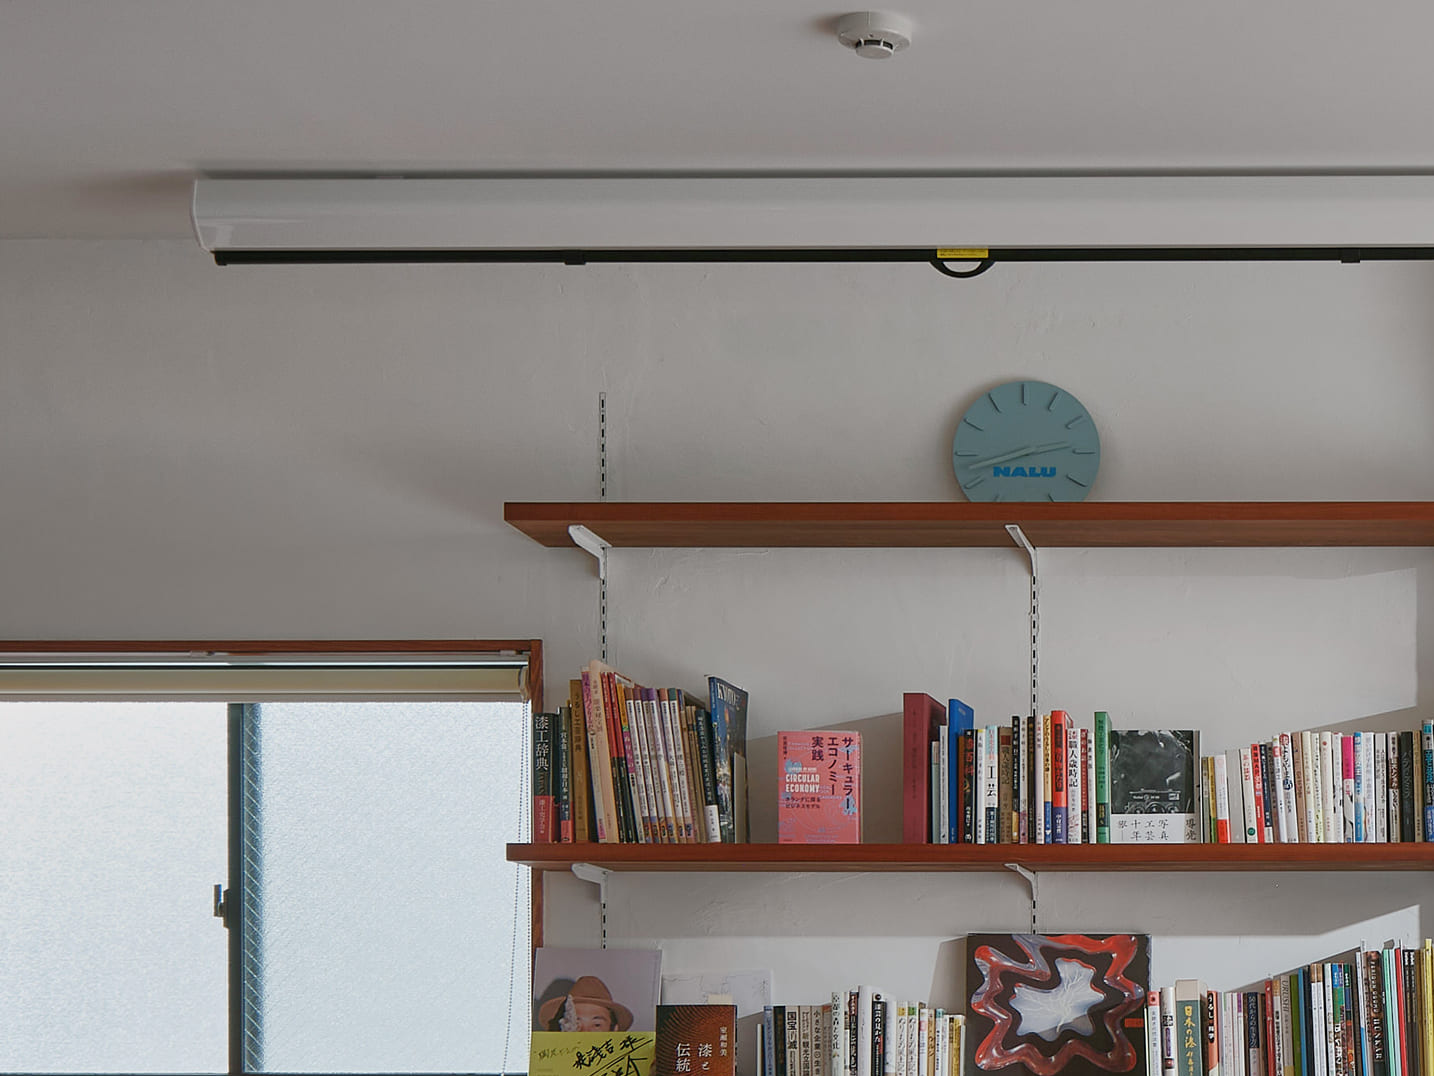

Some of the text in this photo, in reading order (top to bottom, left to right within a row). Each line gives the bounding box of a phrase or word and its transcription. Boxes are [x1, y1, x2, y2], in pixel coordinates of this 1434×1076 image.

[992, 466, 1057, 478] NALU
[535, 716, 550, 771] 漆工辞典
[811, 736, 825, 762] 実践
[785, 773, 820, 783] CIRCULAR
[827, 736, 839, 796] エコノミー
[841, 736, 854, 810] サーキュラー
[785, 783, 820, 793] ECONOMY
[787, 1011, 798, 1050] 国宝消滅
[675, 1043, 691, 1072] 伝統
[697, 1043, 713, 1071] 漆と
